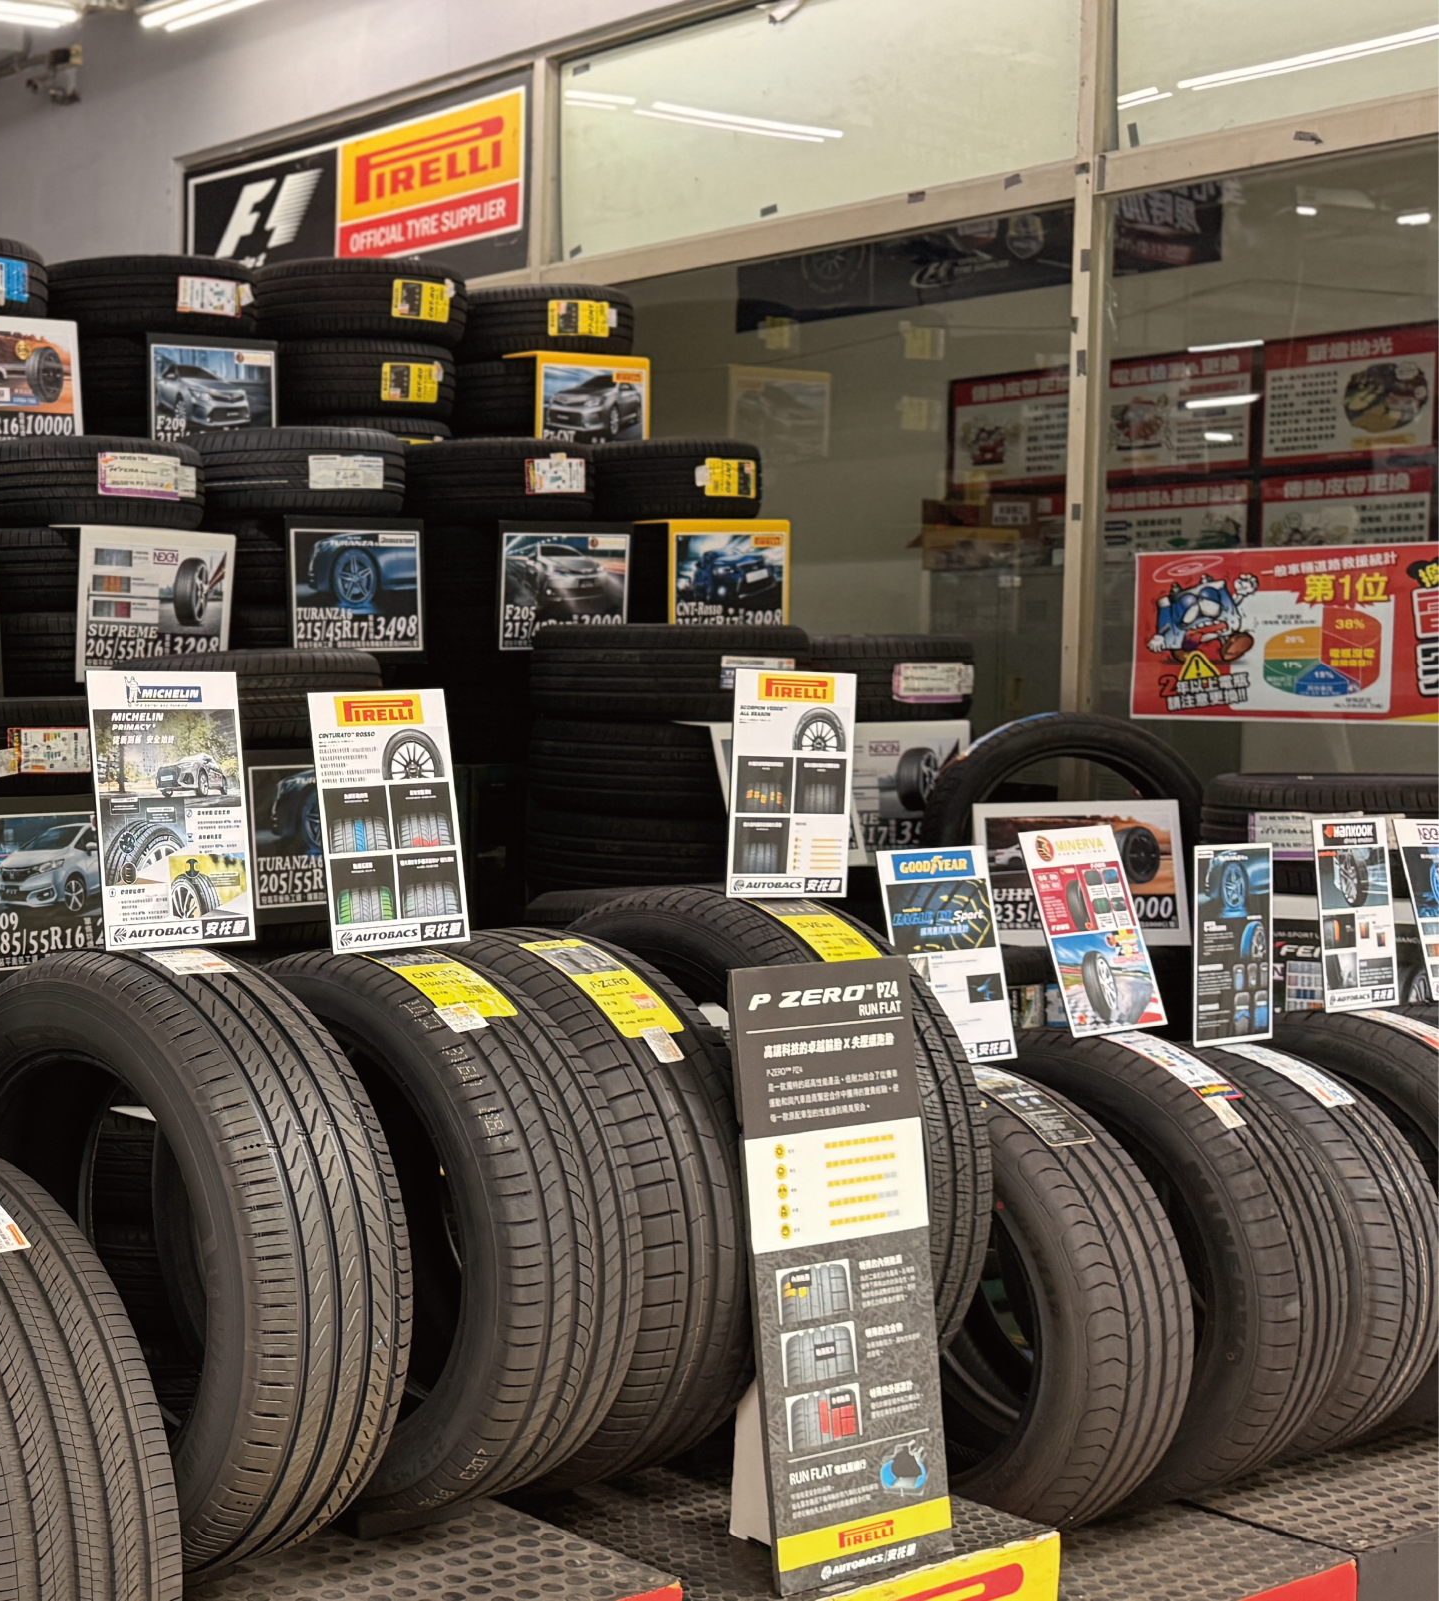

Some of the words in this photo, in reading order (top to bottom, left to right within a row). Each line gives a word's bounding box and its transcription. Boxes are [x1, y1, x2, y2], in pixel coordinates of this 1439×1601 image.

[354, 116, 505, 205] PIRELLI
[215, 168, 323, 259] F1
[349, 230, 405, 253] OFFICIAL
[406, 216, 440, 244] TYRE
[441, 198, 506, 236] SUPPLIER
[25, 414, 73, 437] 10000
[156, 415, 187, 432] F209
[1303, 572, 1388, 603] 第1位
[296, 607, 353, 620] TURANZA6
[504, 604, 537, 621] F205
[676, 602, 723, 617] CNT-Rosso
[87, 623, 159, 639] SUPREME
[297, 620, 368, 642] 215/45R17
[374, 614, 418, 640] 3498
[1335, 618, 1365, 630] 38%
[85, 636, 164, 660] 205/55R16
[141, 688, 200, 699] MICHELIN
[765, 678, 828, 700] PIRELLI
[111, 712, 164, 722] MICHELIN
[343, 699, 414, 722] PIRELLI
[1055, 837, 1104, 852] MINERVA
[899, 857, 968, 876] GOODYEAR
[745, 880, 803, 890] AUTOBACS
[953, 909, 984, 921] Sport
[128, 925, 200, 939] AUTOBACS
[204, 918, 247, 936] 安托華
[353, 928, 418, 943] AUTOBACS
[748, 993, 772, 1011] P
[876, 980, 899, 999] PZ4
[858, 1002, 879, 1017] RUN
[879, 1000, 902, 1014] FLAT
[789, 1470, 810, 1486] RUN
[810, 1464, 833, 1481] FLAT
[838, 1519, 894, 1549] PIRELLI
